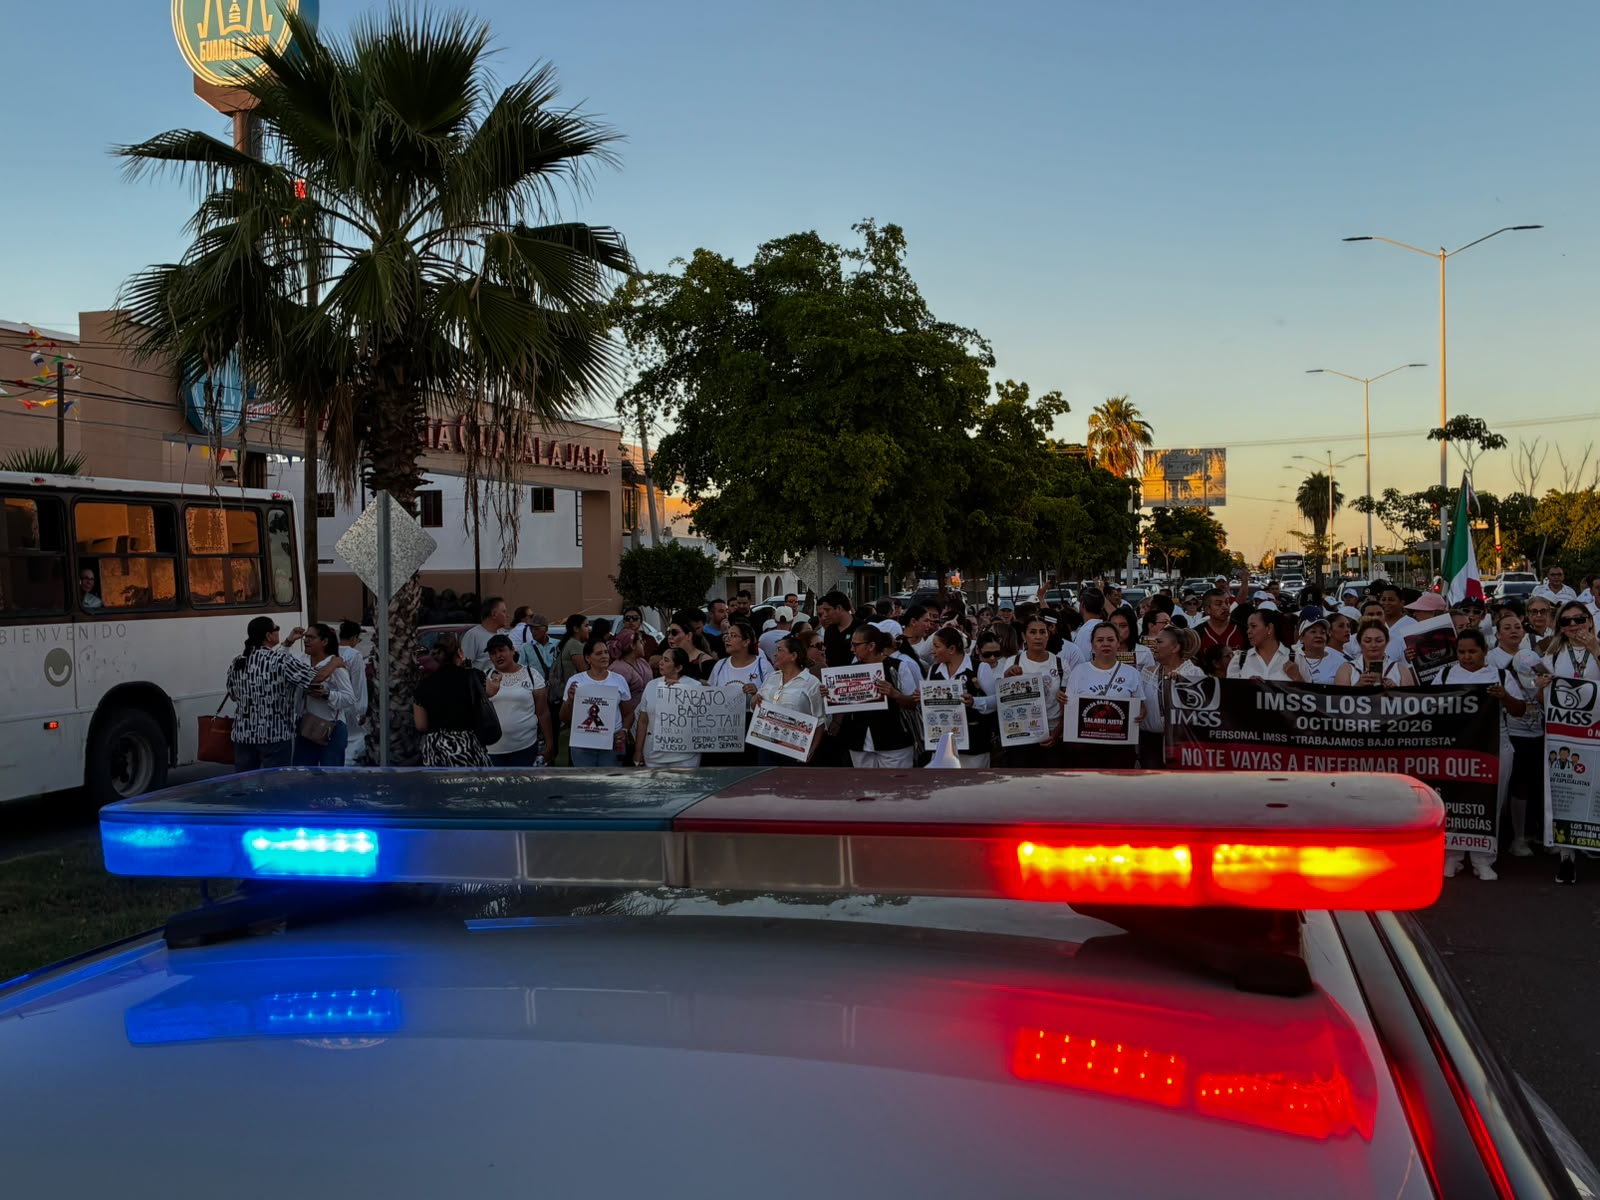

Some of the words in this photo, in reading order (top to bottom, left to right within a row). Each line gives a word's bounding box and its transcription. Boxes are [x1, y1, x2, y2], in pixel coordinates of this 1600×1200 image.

[0, 623, 126, 645] BIENVENIDO
[678, 704, 707, 716] BAJO
[1256, 691, 1317, 713] IMSS
[1325, 695, 1372, 714] LOS
[1380, 695, 1479, 715] MOCHIS
[1170, 709, 1222, 728] IMSS
[1296, 715, 1381, 733] OCTUBRE
[1386, 719, 1433, 733] 2026
[1547, 707, 1593, 726] IMSS
[1209, 729, 1260, 741] PERSONAL
[1263, 732, 1287, 742] IMSS
[1367, 738, 1395, 747] BAJO
[1181, 747, 1203, 767] NO
[1205, 748, 1226, 768] TE
[1231, 750, 1282, 770] VAYAS
[1287, 753, 1299, 771] A
[1304, 754, 1399, 773] ENFERMAR
[1404, 756, 1440, 776] POR
[1445, 816, 1493, 831] CIRUGÍAS
[1570, 822, 1583, 830] LOS
[1570, 836, 1576, 845] Y
